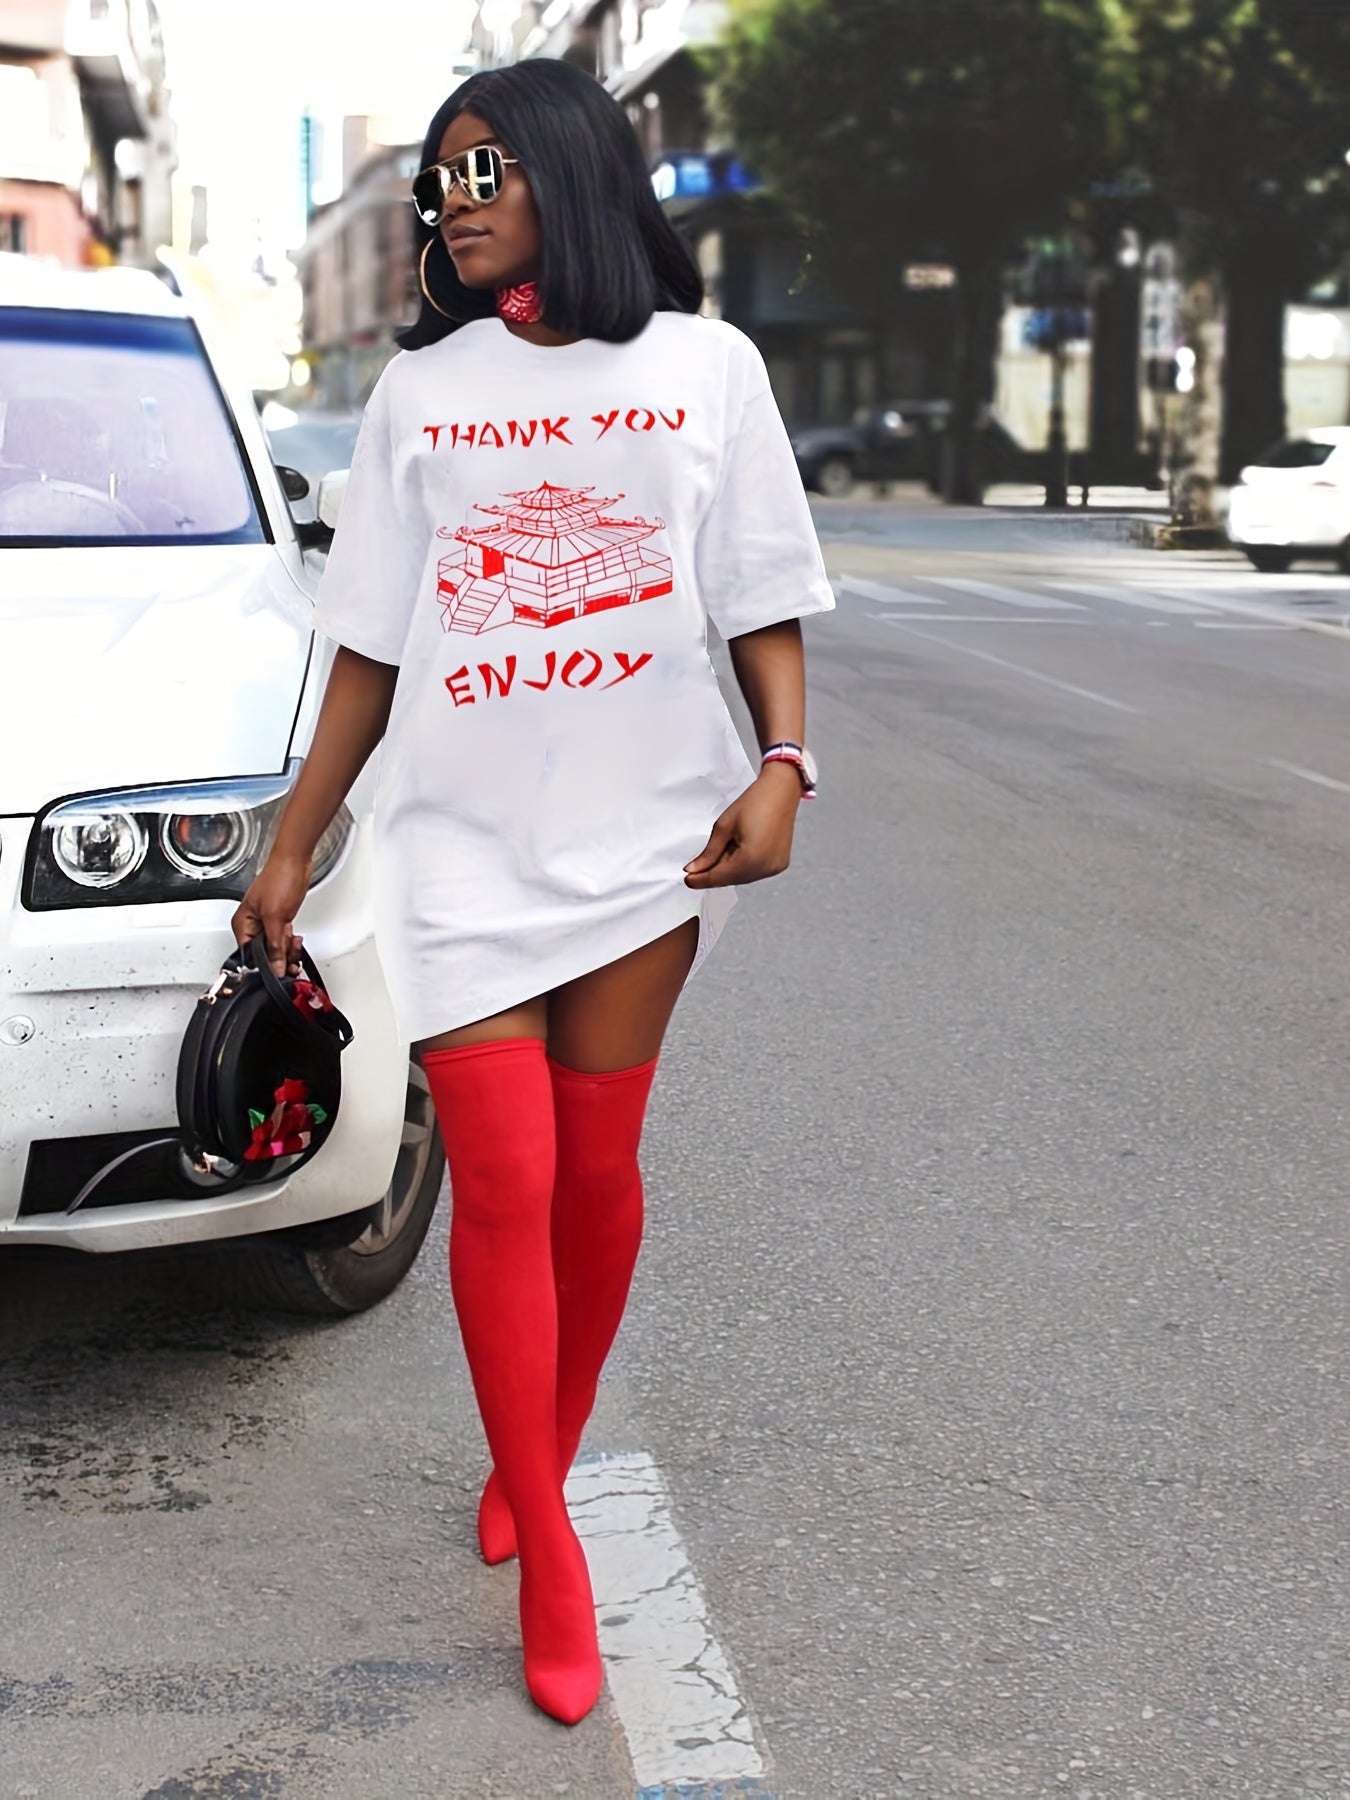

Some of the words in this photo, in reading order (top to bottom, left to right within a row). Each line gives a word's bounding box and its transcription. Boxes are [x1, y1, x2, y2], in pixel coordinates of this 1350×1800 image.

[423, 415, 574, 451] THANK
[591, 408, 686, 441] YOU
[444, 648, 654, 707] ENJOY
